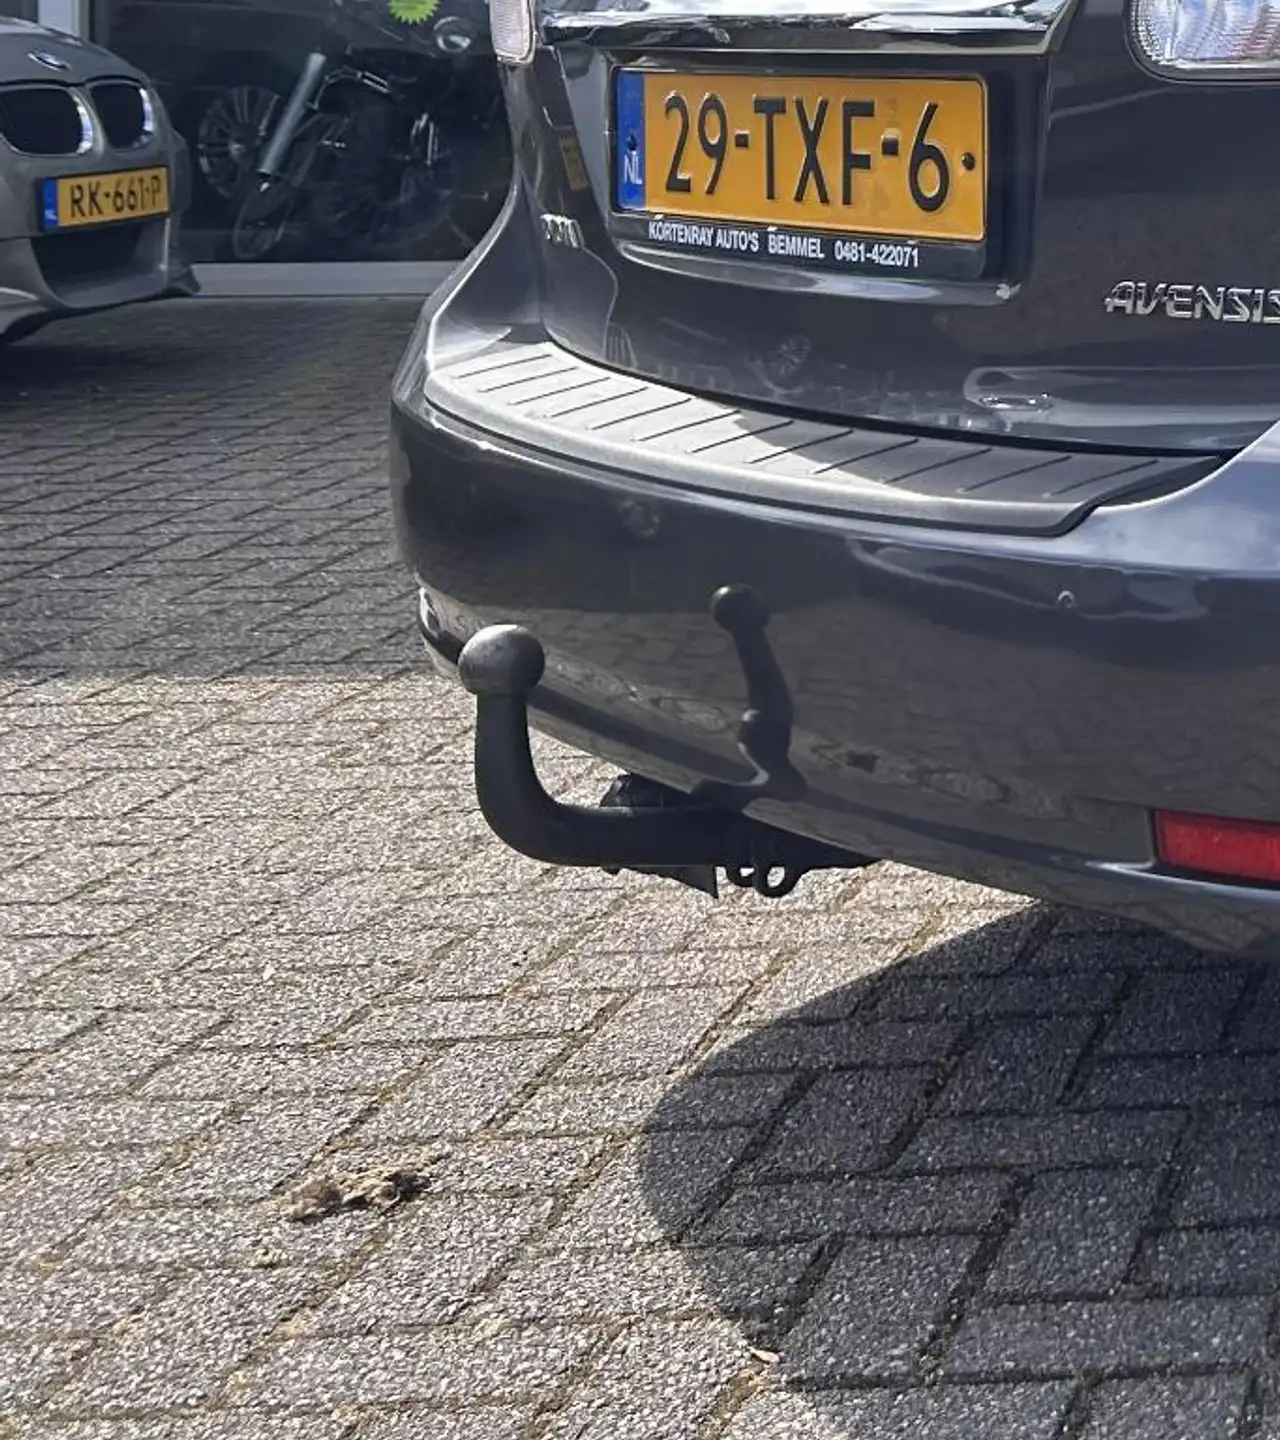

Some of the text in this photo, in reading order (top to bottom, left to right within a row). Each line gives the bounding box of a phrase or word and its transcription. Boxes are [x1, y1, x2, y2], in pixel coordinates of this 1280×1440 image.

[623, 90, 950, 213] NL 29-TXF-6
[70, 175, 162, 218] RK-661-P
[649, 220, 919, 268] KORTENRAY AUTO'S BEMMEL 0481-422071
